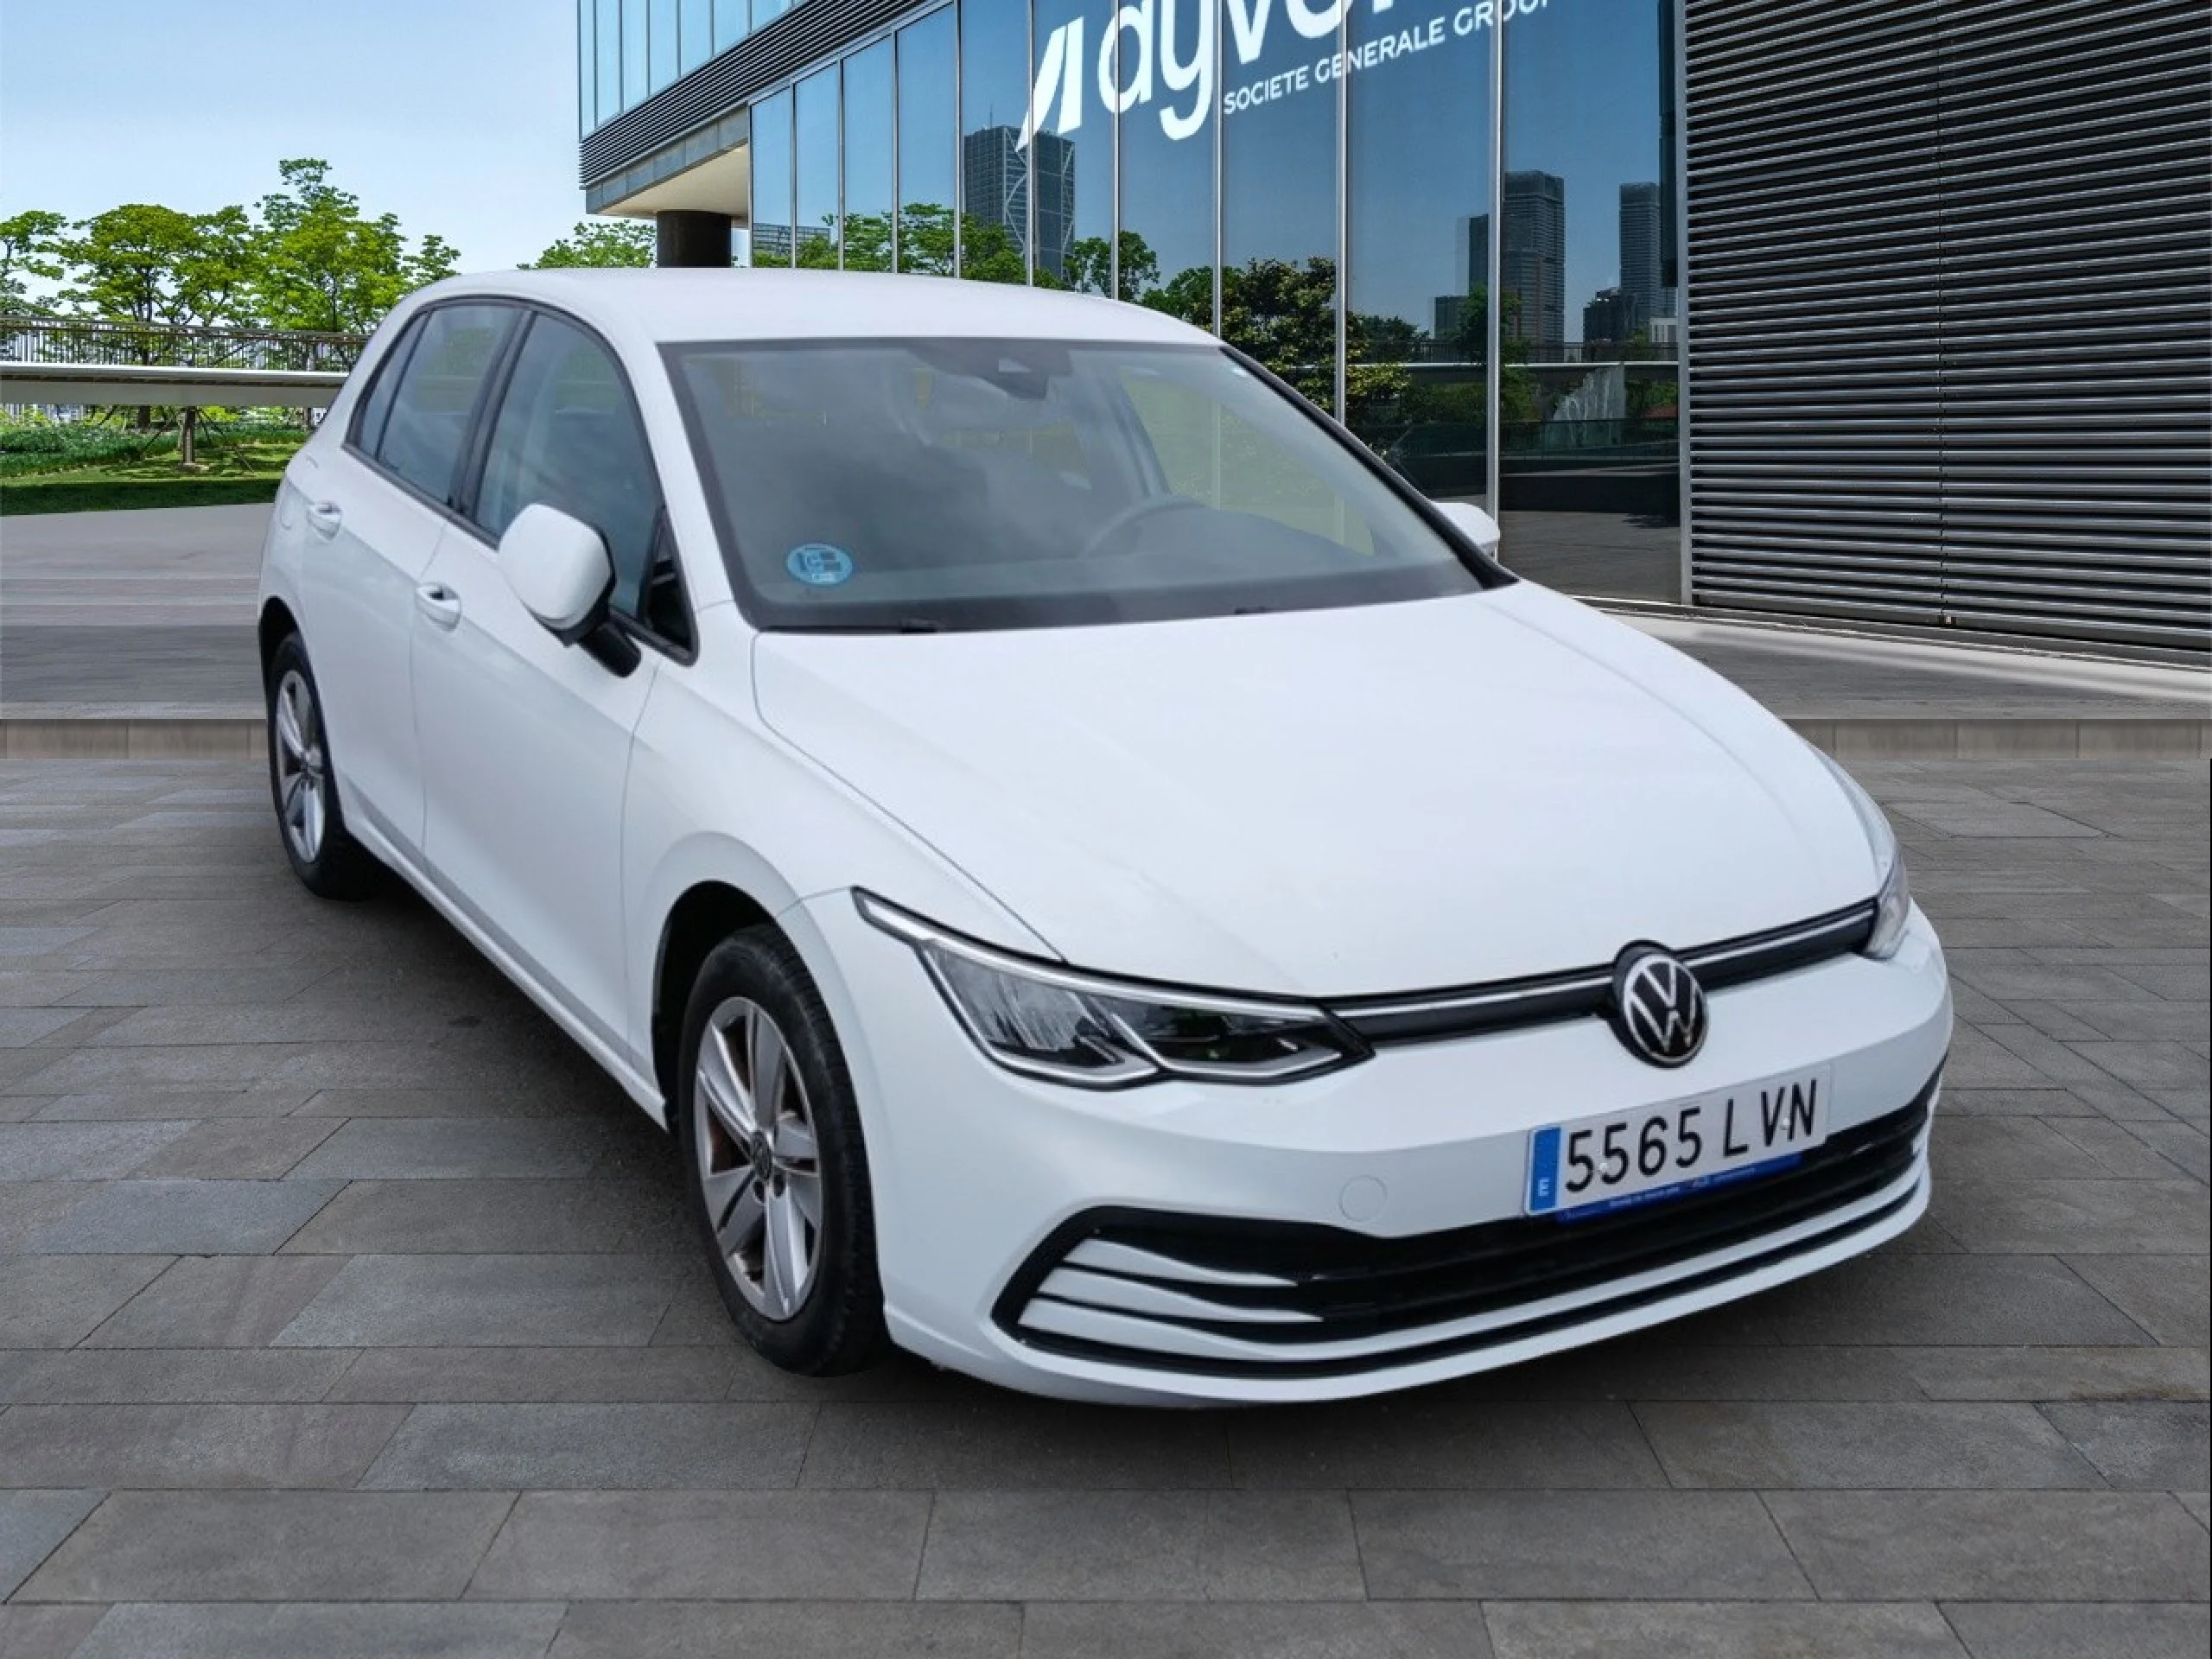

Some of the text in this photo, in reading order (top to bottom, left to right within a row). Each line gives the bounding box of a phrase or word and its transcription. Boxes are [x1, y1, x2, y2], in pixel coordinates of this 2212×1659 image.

[1098, 0, 1391, 141] ayv
[1224, 0, 1548, 114] SOCIETE GENERALE GRU
[1537, 1178, 1549, 1197] E
[1566, 1078, 1816, 1192] 5565 LVN
